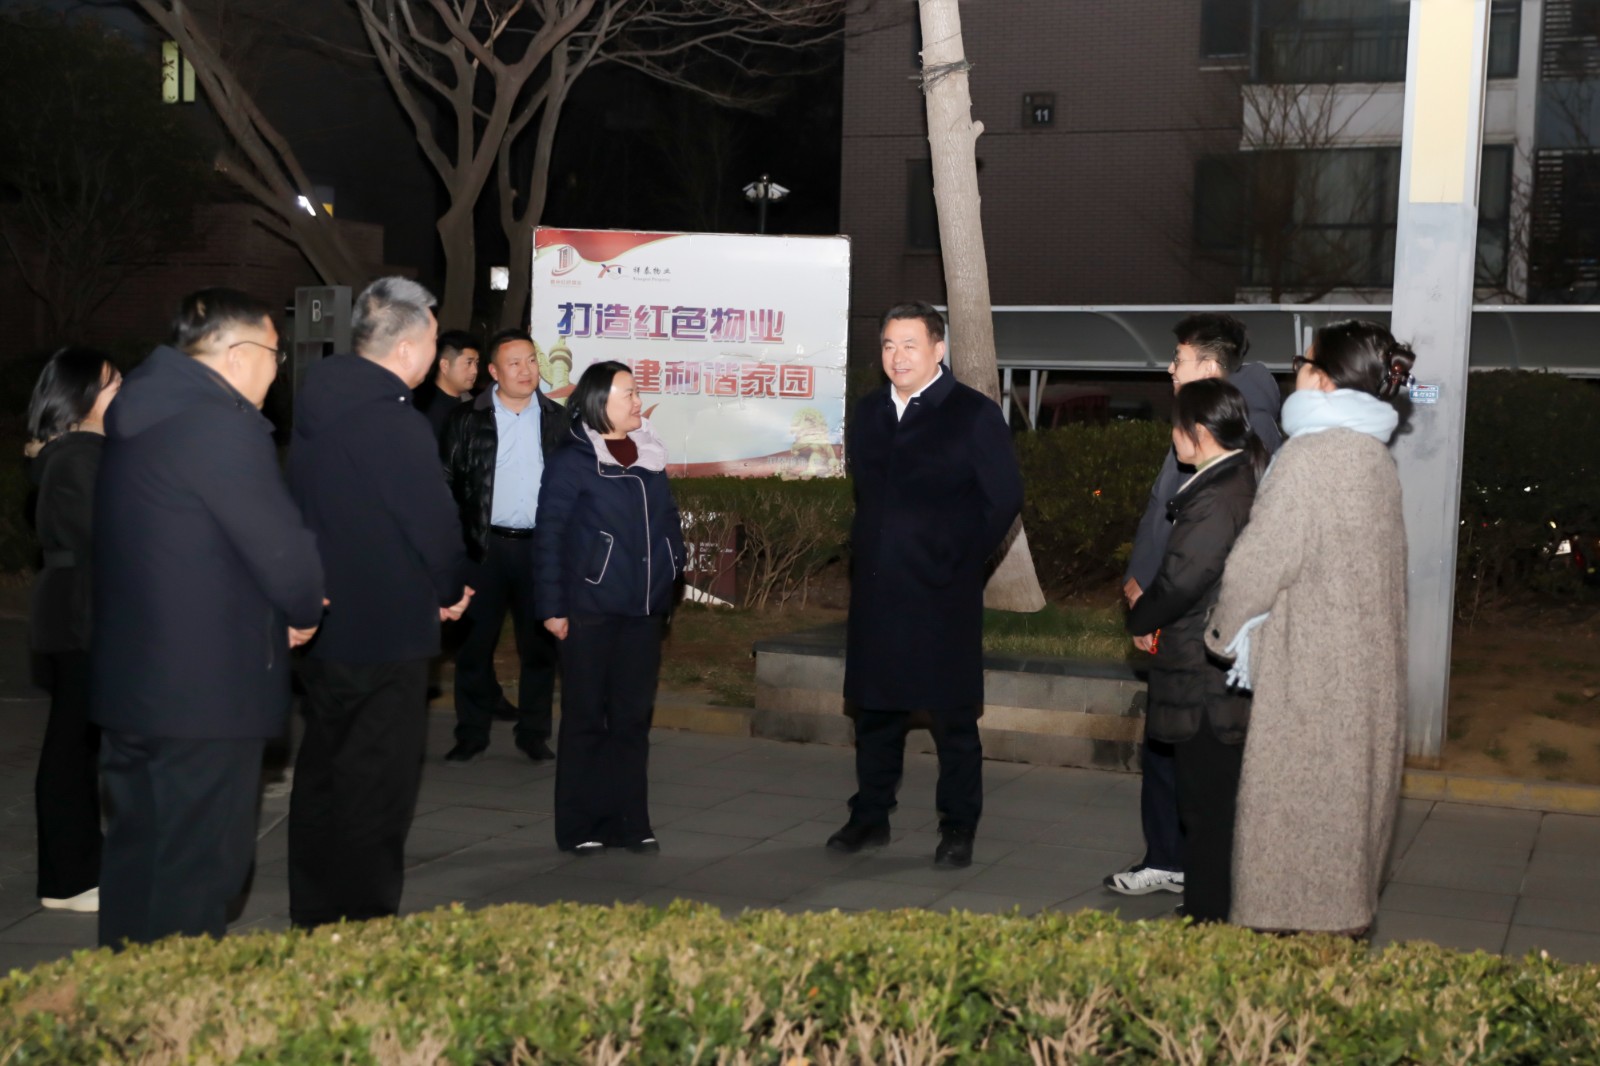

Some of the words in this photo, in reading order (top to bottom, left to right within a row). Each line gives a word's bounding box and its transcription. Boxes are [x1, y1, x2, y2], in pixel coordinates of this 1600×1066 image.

[1035, 107, 1049, 122] 11
[312, 300, 321, 322] B
[557, 301, 784, 343] 打造红色物业
[591, 356, 816, 400] 建和谐家园
